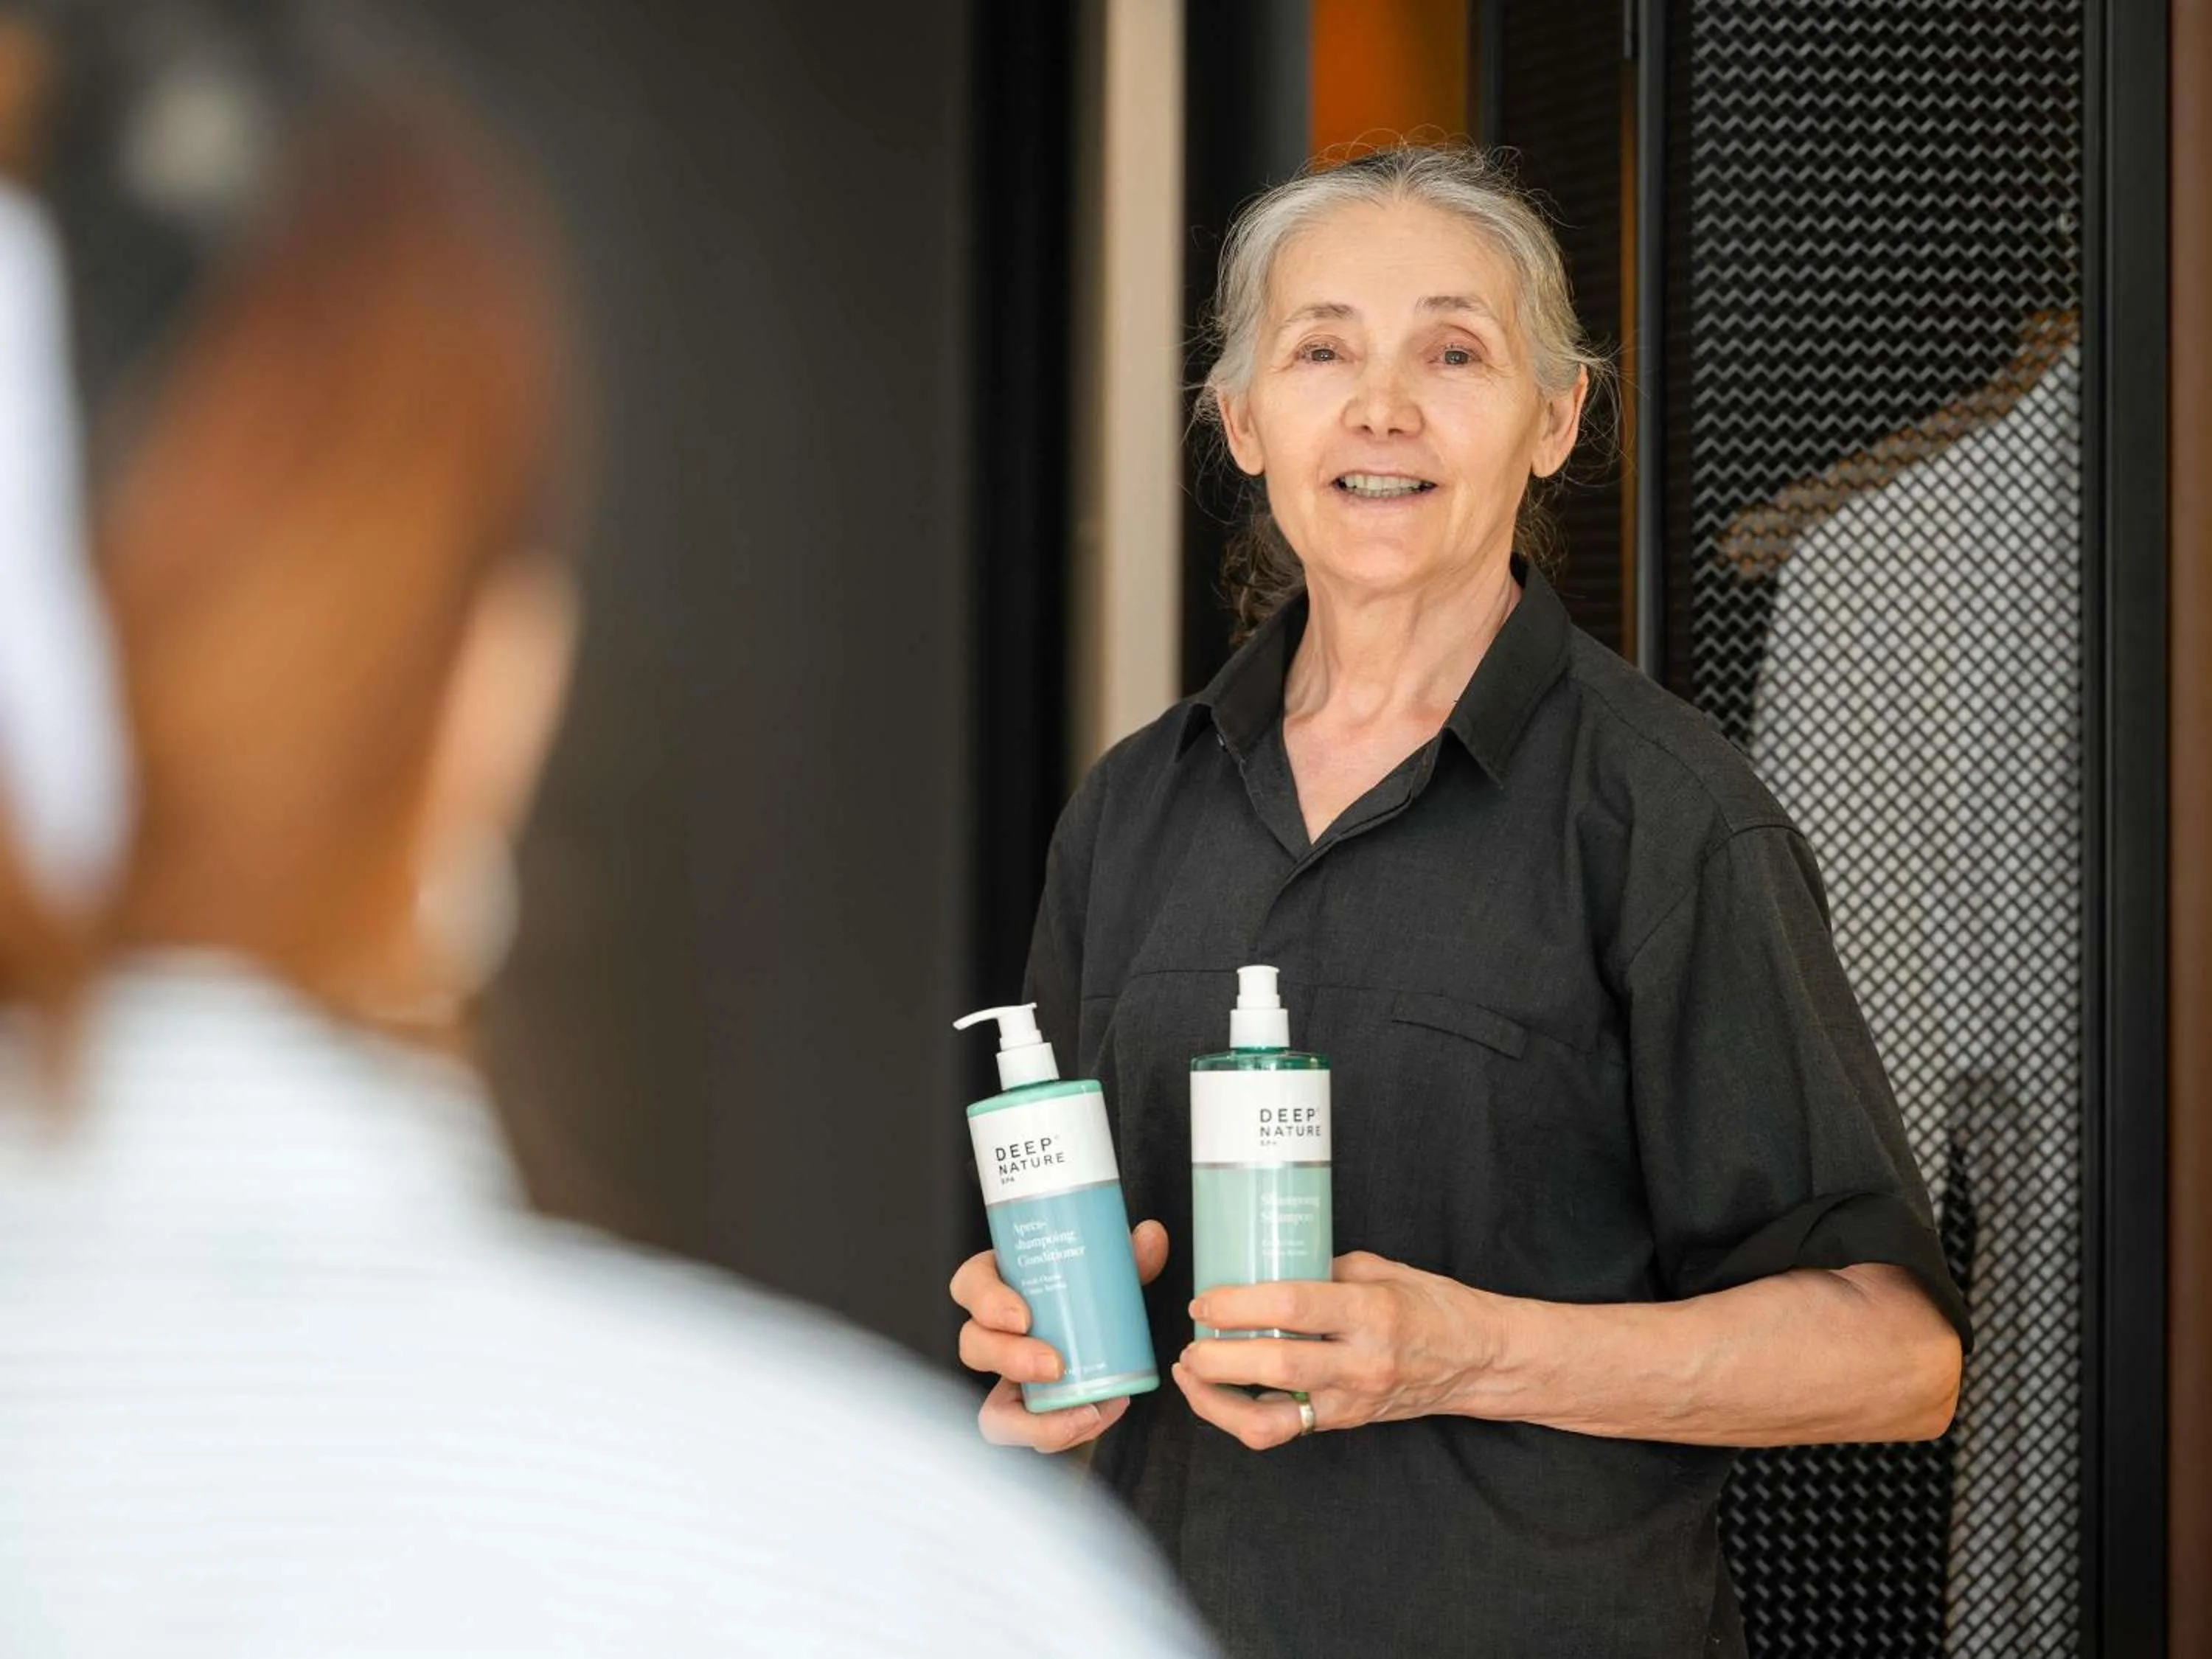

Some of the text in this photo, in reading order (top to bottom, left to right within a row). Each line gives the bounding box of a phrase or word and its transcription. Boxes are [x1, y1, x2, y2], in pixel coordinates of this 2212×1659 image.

[1260, 1108, 1315, 1123] DEEP
[1260, 1125, 1321, 1136] NATURE
[995, 1137, 1051, 1161] DEEP
[999, 1152, 1065, 1175] NATURE
[1018, 1246, 1085, 1267] Conditioner
